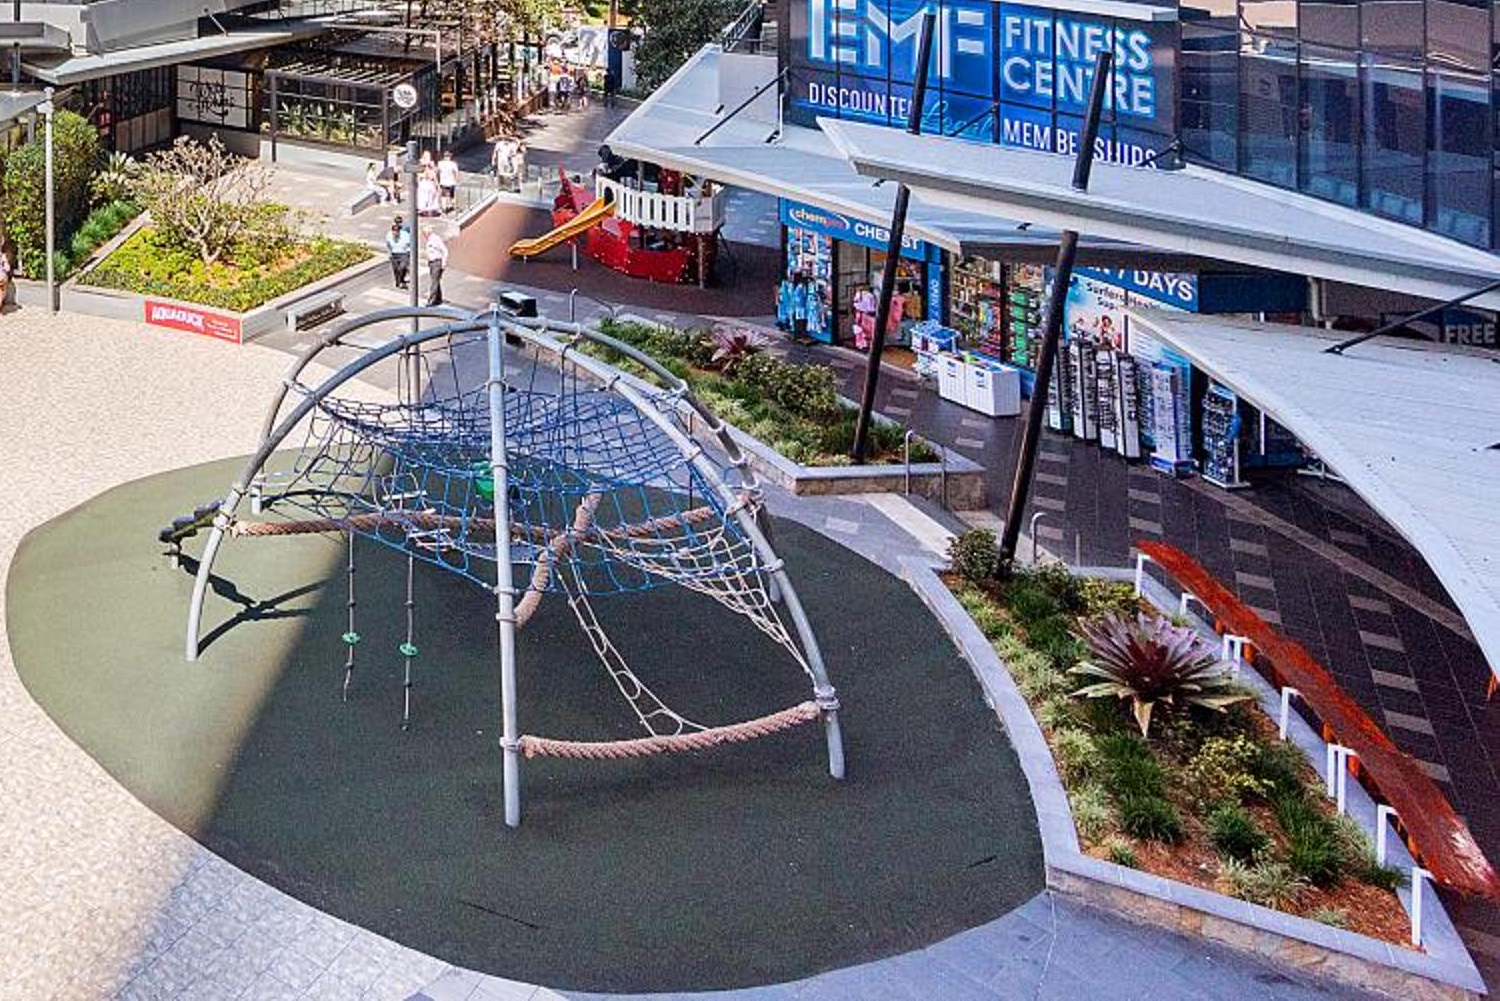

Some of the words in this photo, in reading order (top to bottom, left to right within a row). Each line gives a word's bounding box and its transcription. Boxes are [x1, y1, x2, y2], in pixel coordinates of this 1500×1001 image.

[1004, 15, 1150, 71] FITNESS
[1003, 117, 1158, 170] MEMBESHIPS
[854, 221, 920, 250] CHEMST
[1133, 268, 1194, 302] DAYS
[1444, 323, 1497, 345] FREE
